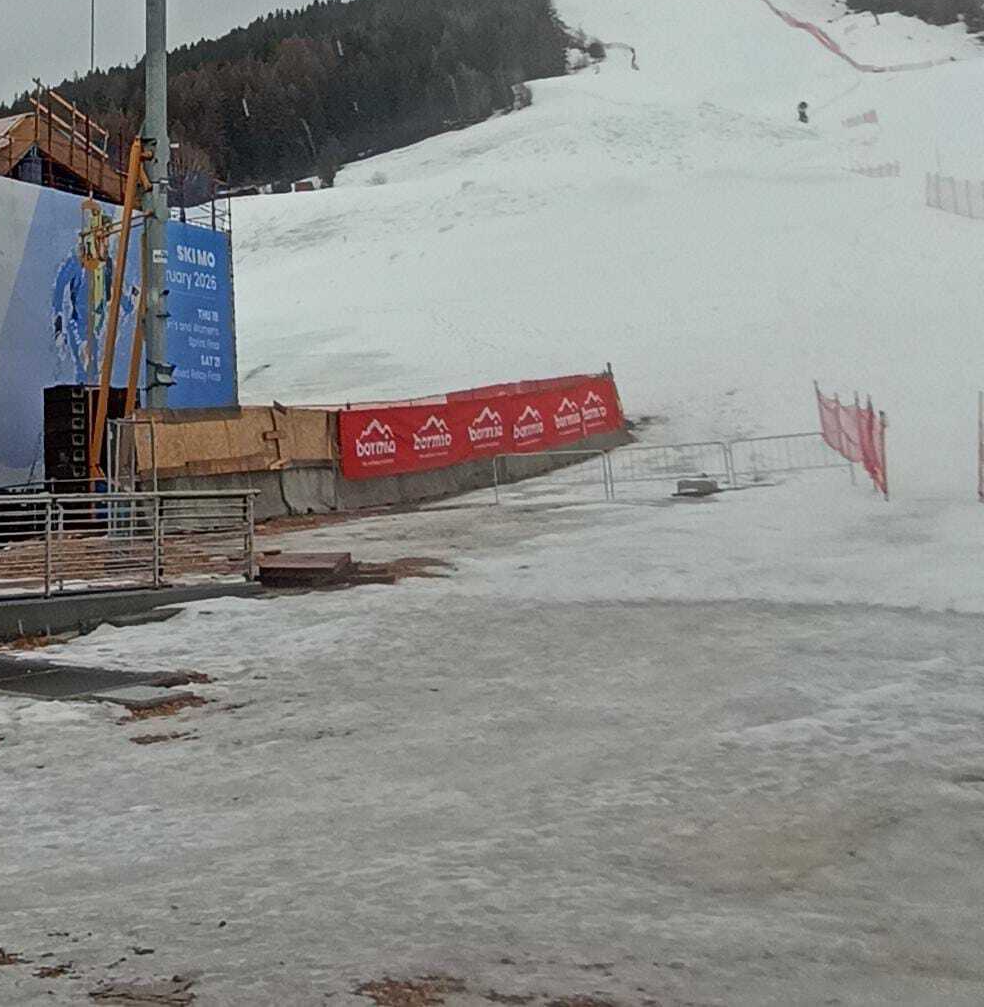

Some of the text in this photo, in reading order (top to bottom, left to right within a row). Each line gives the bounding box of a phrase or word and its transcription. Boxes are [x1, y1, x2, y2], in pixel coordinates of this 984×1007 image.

[412, 427, 453, 450] bormio
[468, 420, 503, 442] bormio
[513, 416, 544, 439] bormio
[355, 434, 397, 457] bormio
